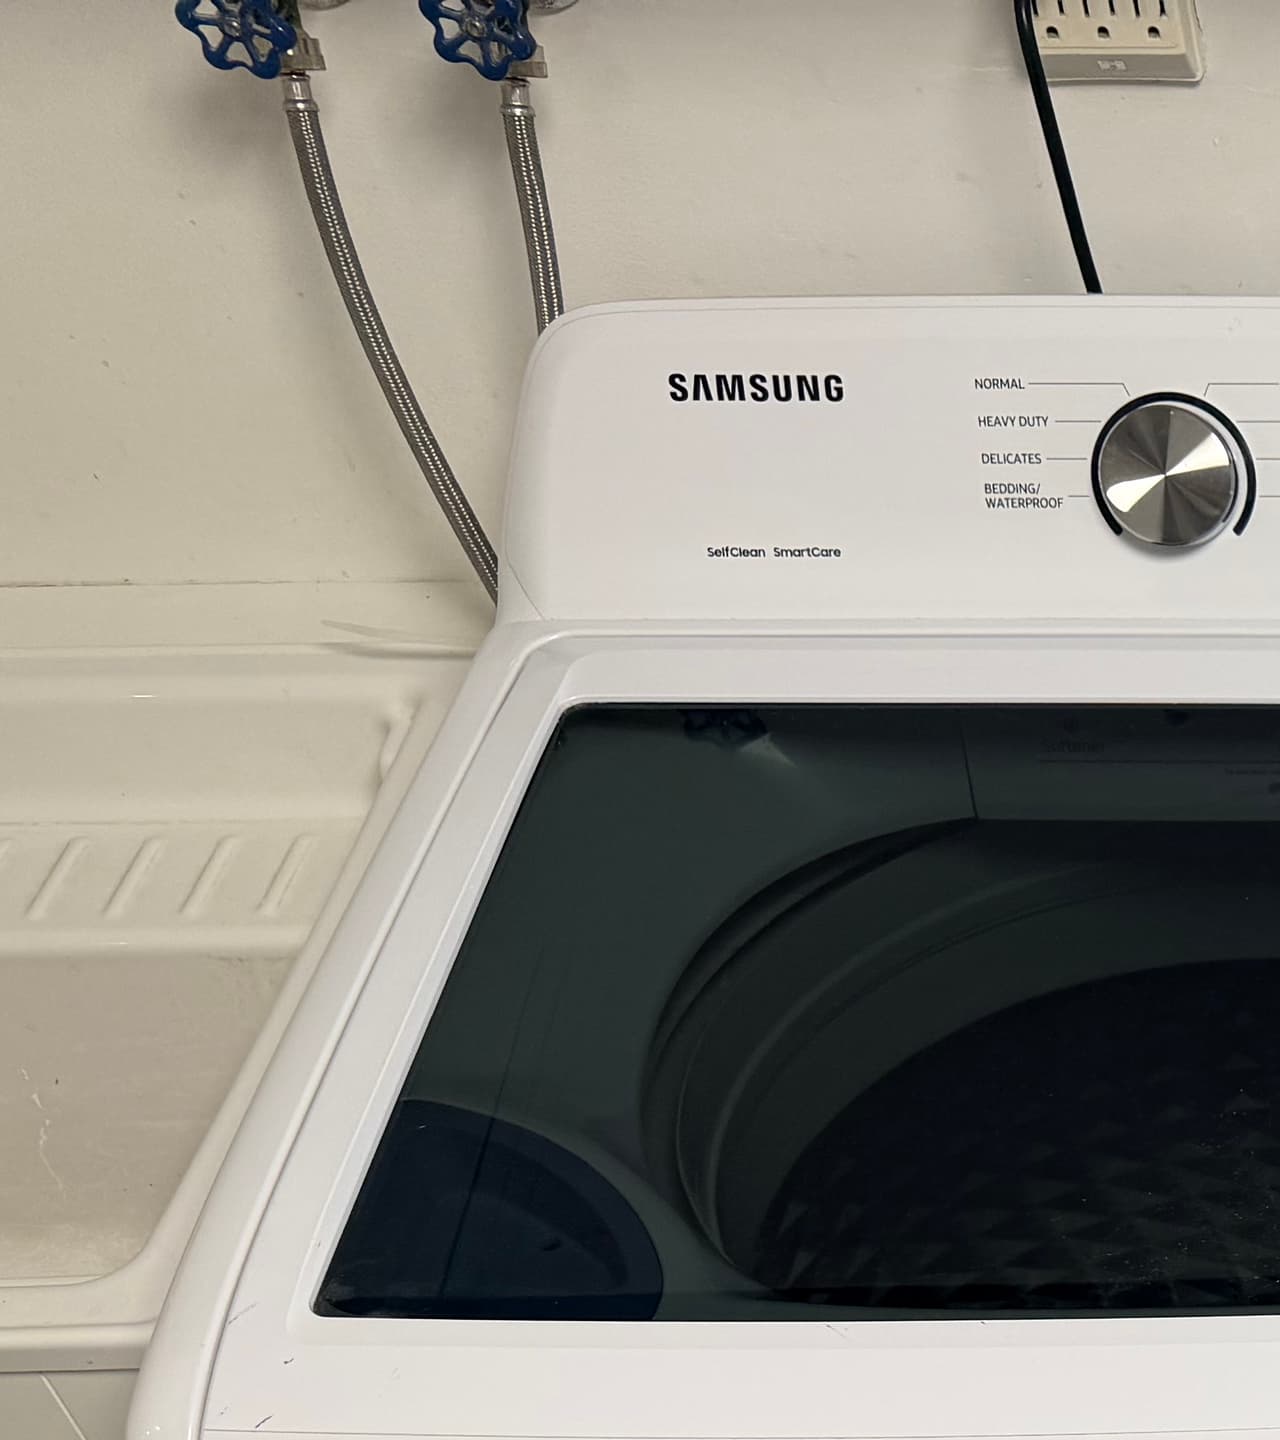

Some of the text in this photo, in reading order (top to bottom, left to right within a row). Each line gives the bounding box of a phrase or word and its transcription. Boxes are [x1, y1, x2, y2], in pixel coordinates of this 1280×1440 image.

[668, 373, 844, 402] SAMSUNG
[975, 378, 1025, 390] NORMAL
[978, 416, 1049, 428] HEAVY DUTY
[982, 453, 1042, 465] DELICATES
[984, 483, 1040, 495] BEDDING/
[985, 497, 1063, 509] WATERPROOF
[707, 546, 841, 558] SelfClean SmartCare
